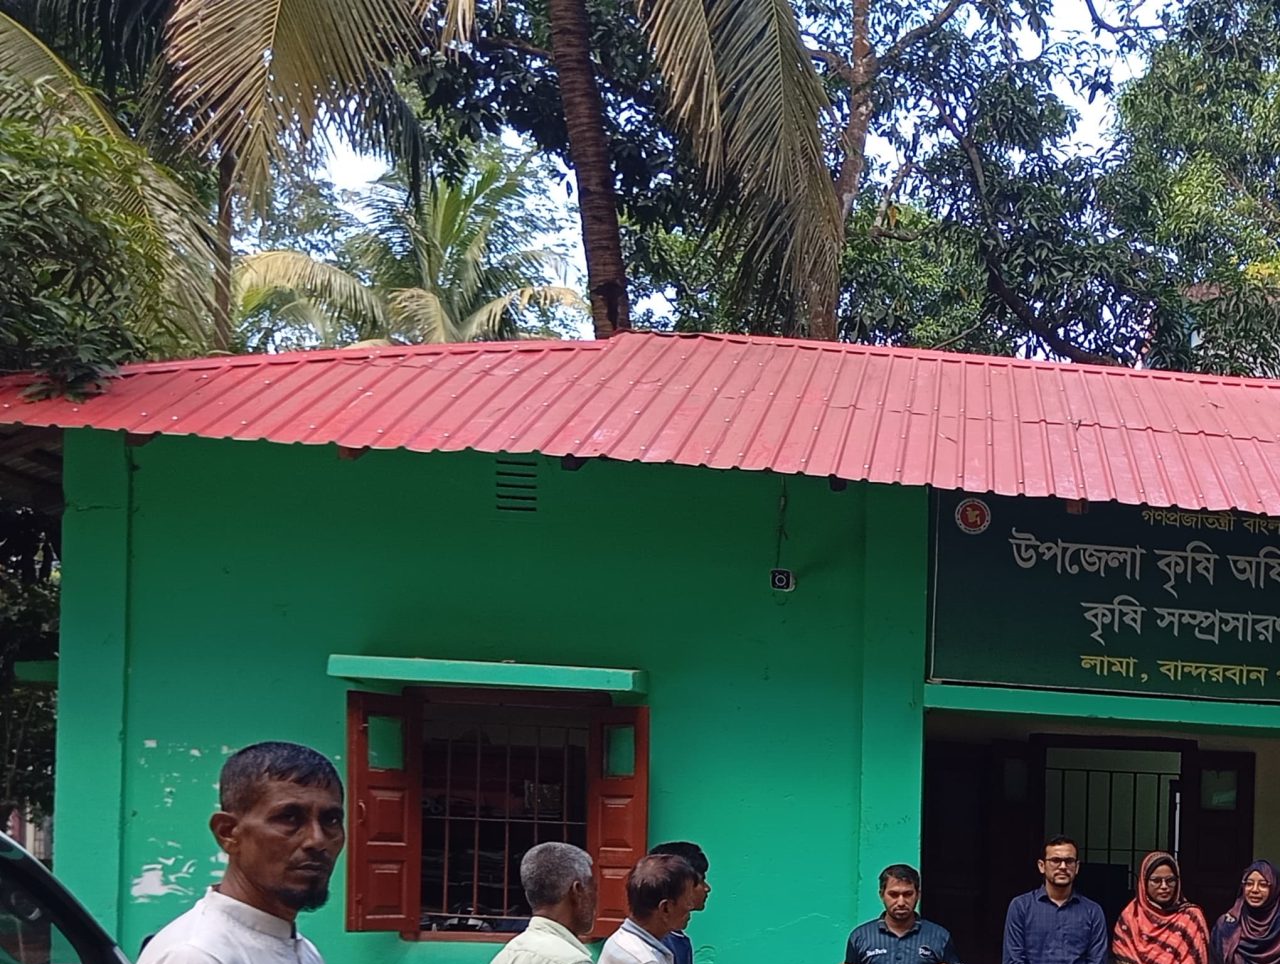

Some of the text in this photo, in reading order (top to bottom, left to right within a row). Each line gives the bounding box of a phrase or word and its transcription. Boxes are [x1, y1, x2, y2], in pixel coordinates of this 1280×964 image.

[1009, 528, 1147, 580] উপজেলা
[1154, 541, 1220, 599] কৃষি
[1081, 595, 1148, 646] কৃষি
[1158, 660, 1269, 686] বান্দরবান
